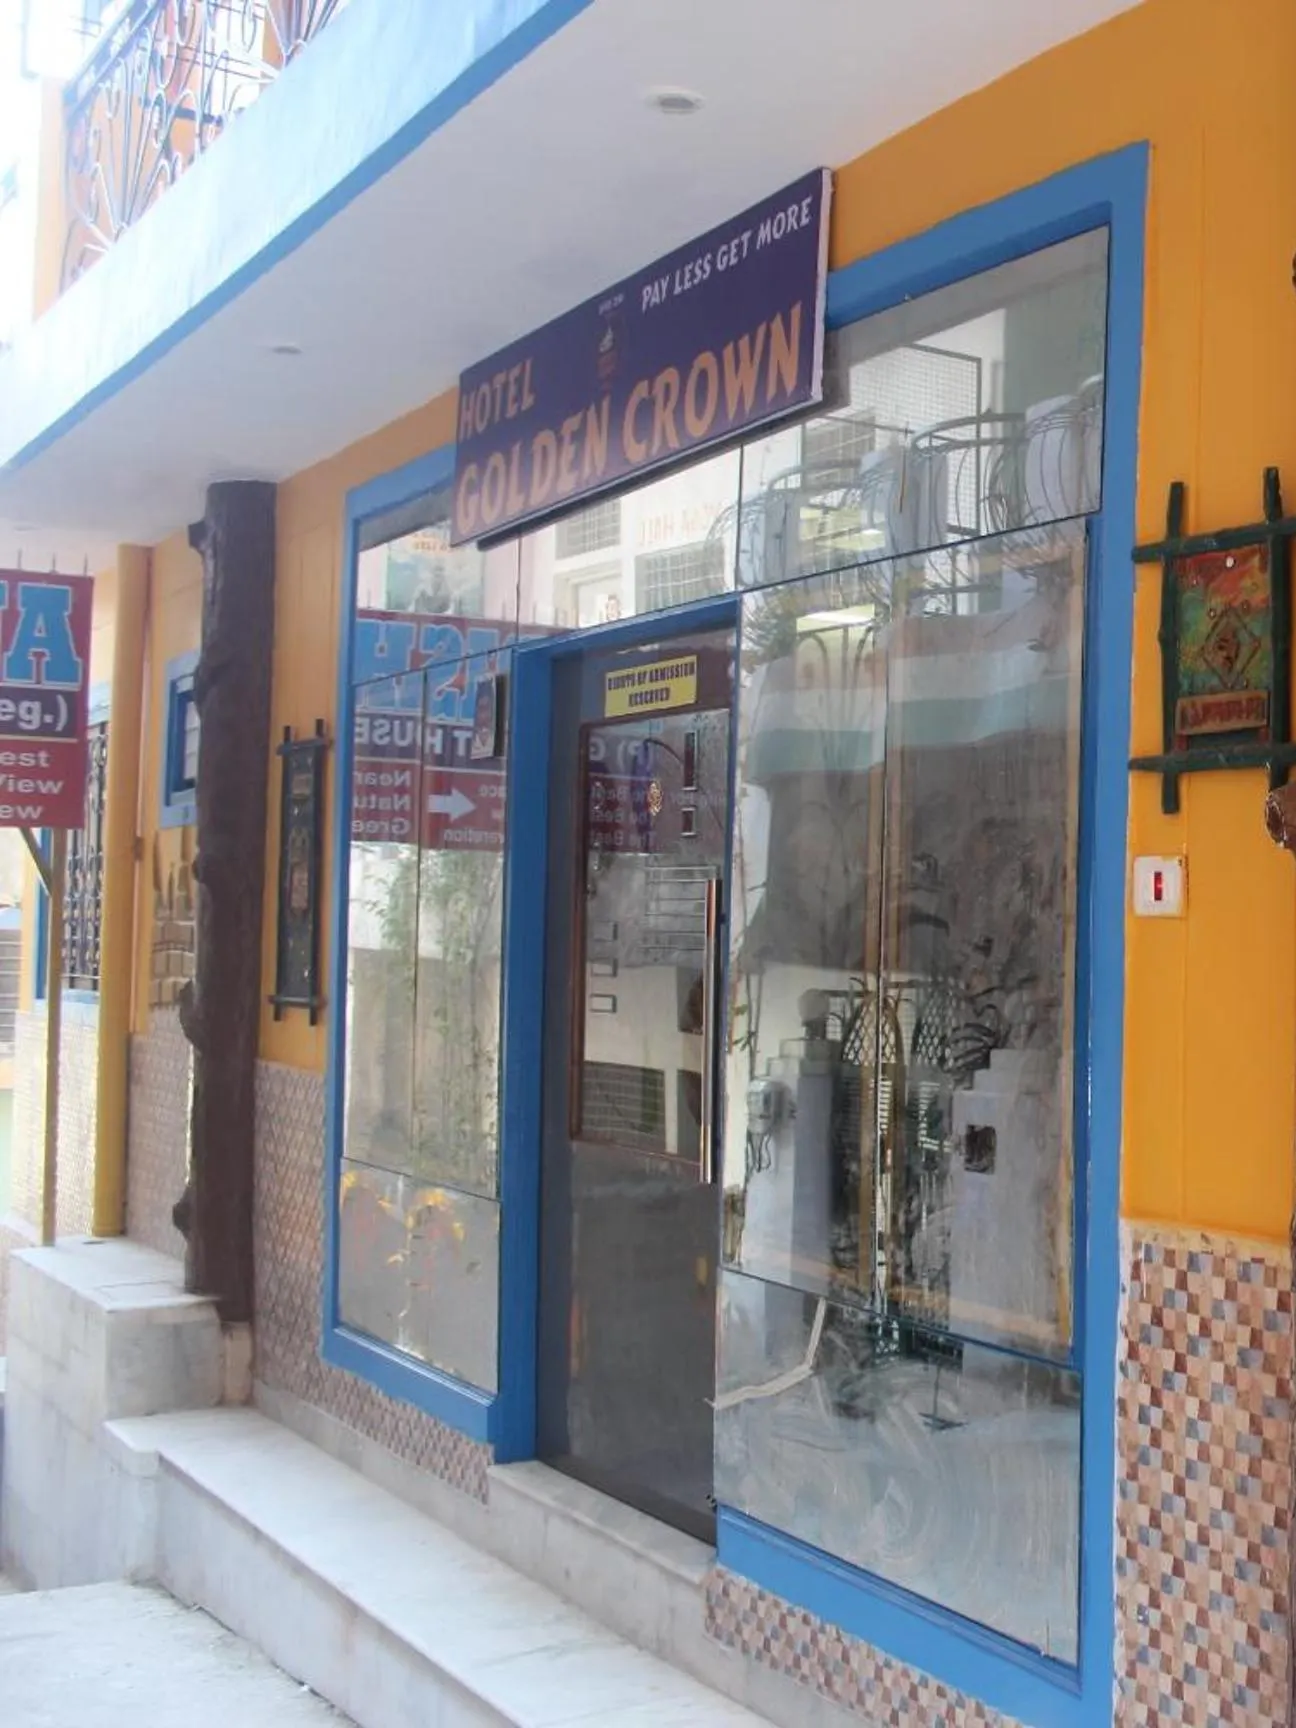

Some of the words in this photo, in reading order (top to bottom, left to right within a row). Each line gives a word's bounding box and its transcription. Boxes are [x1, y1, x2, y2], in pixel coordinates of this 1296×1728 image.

[642, 275, 670, 313] PAY
[673, 252, 712, 295] LESS
[716, 229, 752, 272] GET
[756, 196, 813, 250] MORE
[455, 394, 611, 536] GOLDEN
[622, 300, 802, 463] CROWN
[459, 357, 534, 442] HOTEL
